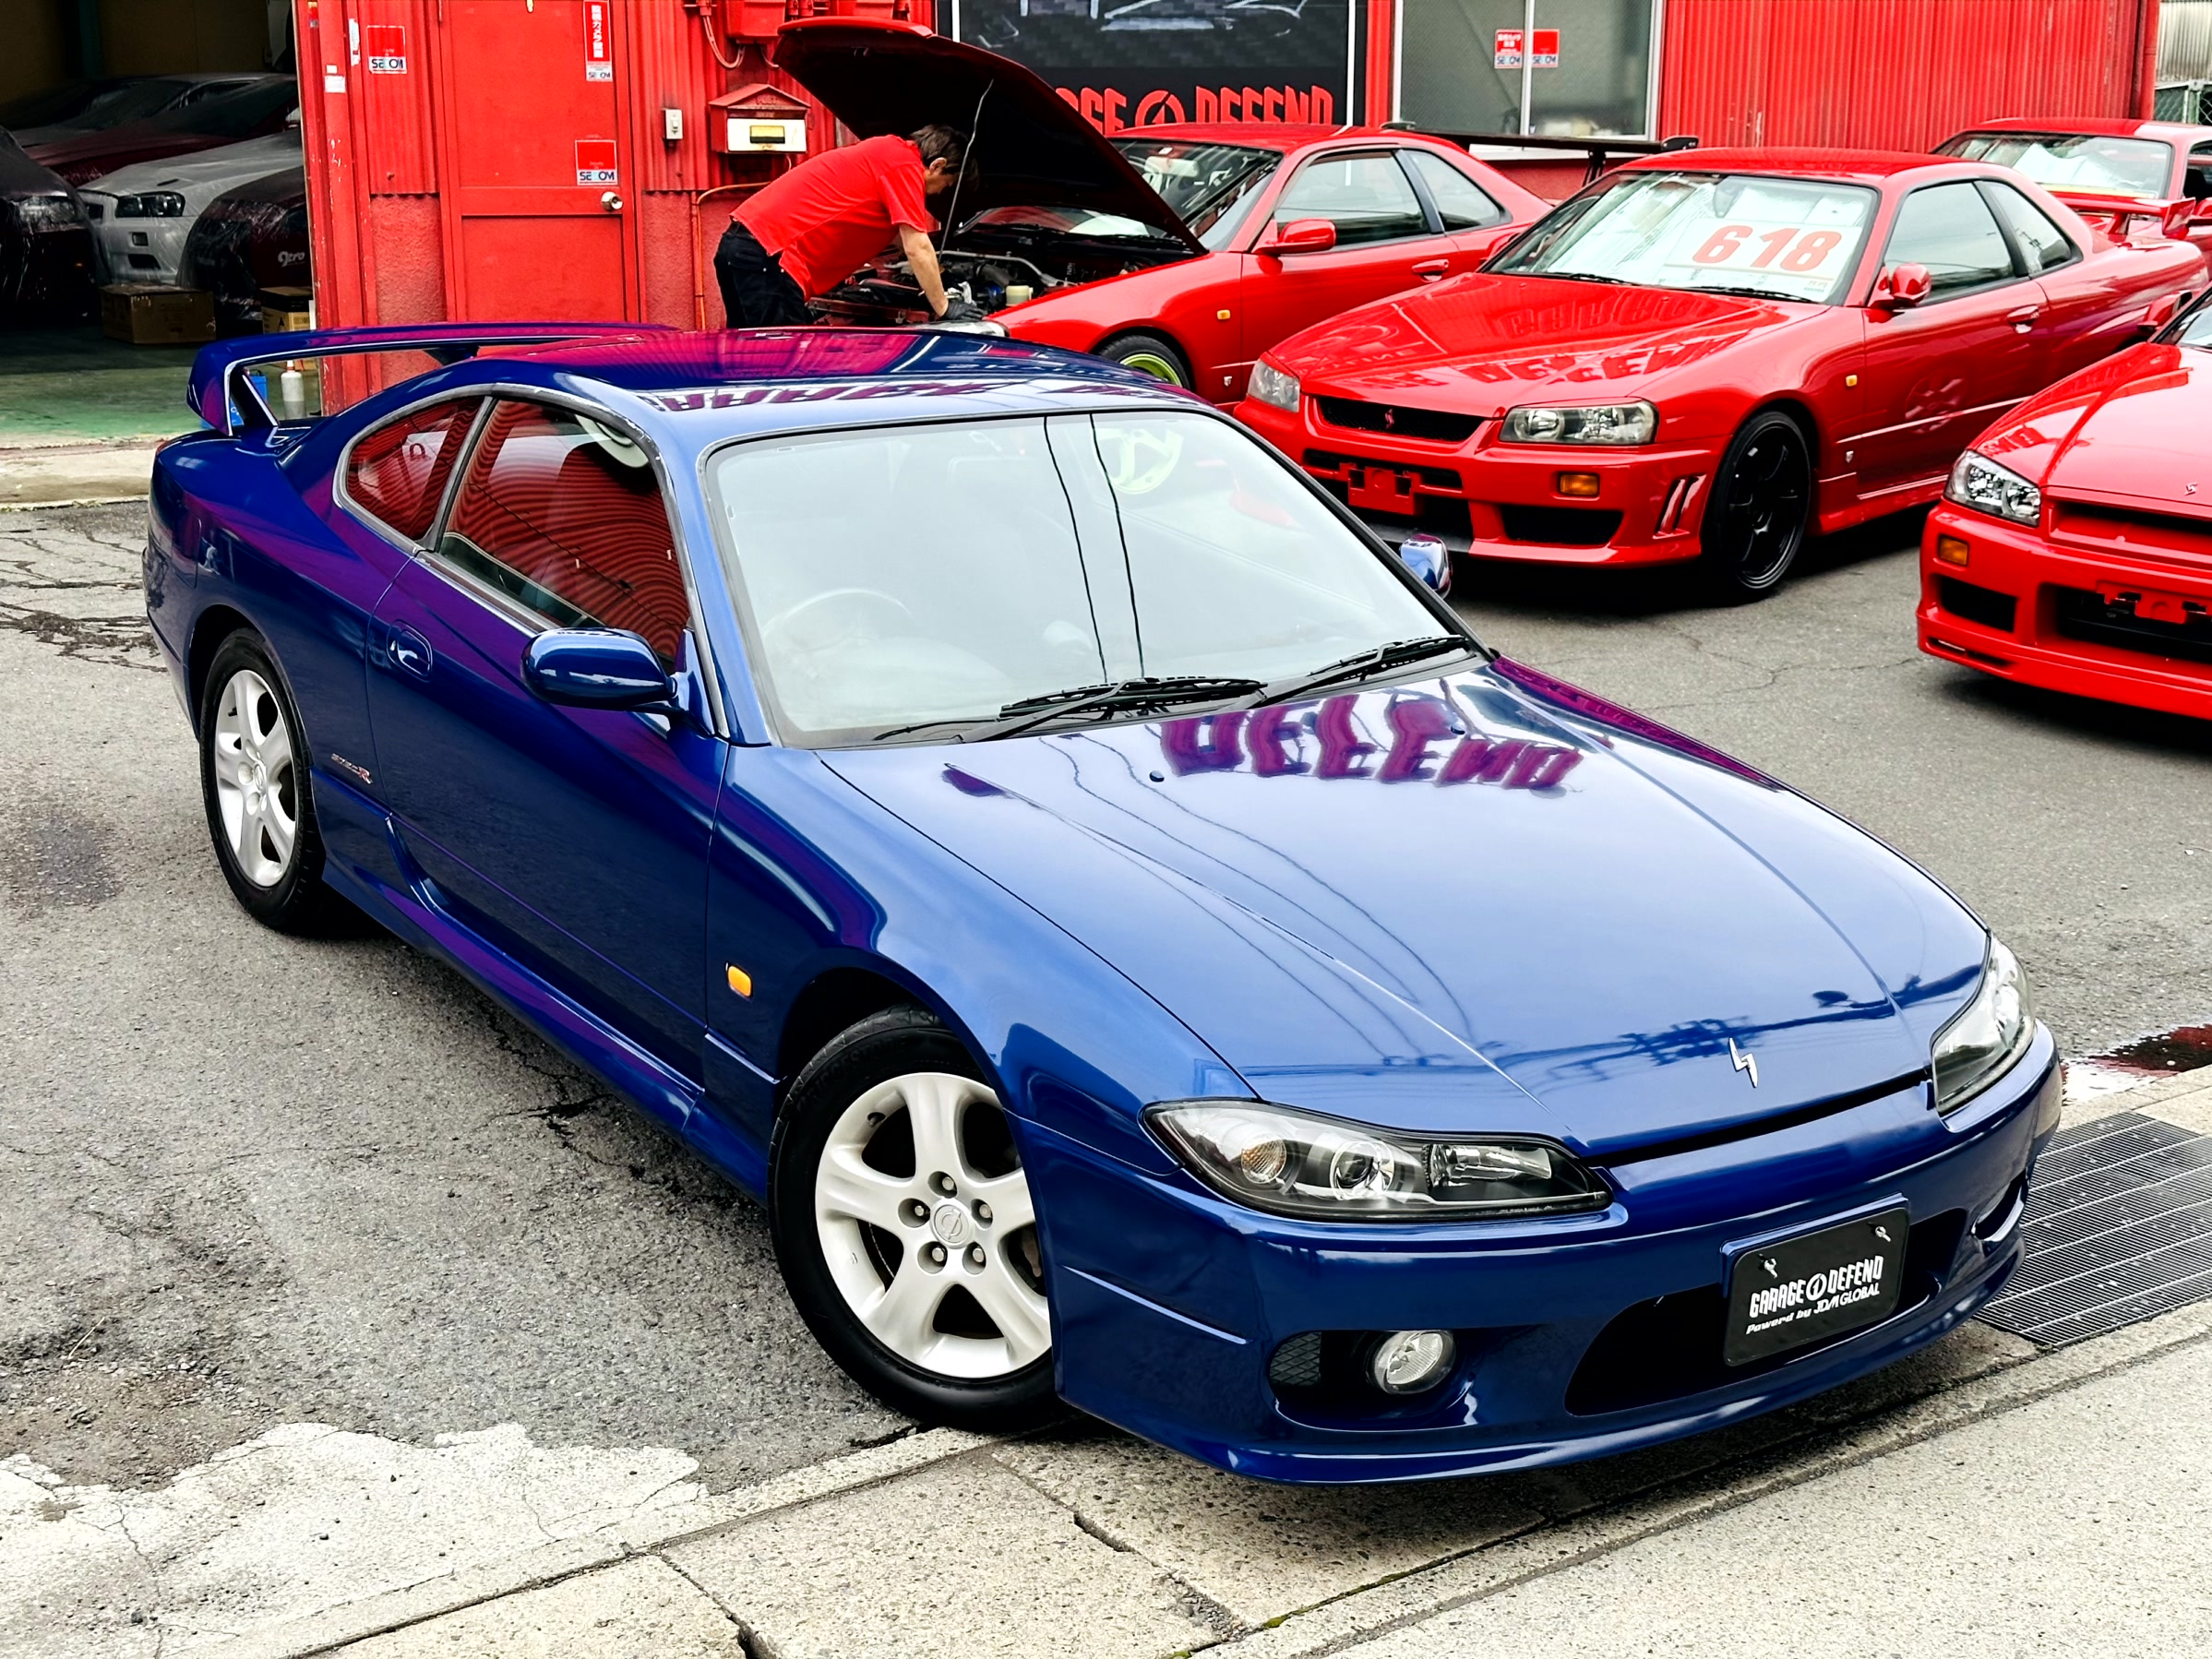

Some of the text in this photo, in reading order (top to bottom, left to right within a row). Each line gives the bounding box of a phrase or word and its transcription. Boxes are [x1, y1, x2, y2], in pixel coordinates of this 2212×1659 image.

[1497, 56, 1521, 65] SEOM
[1195, 85, 1334, 125] DEFEND
[1692, 224, 1843, 272] 618
[1749, 1255, 1884, 1319] GARAGE DEFEND
[1795, 1307, 1812, 1319] by
